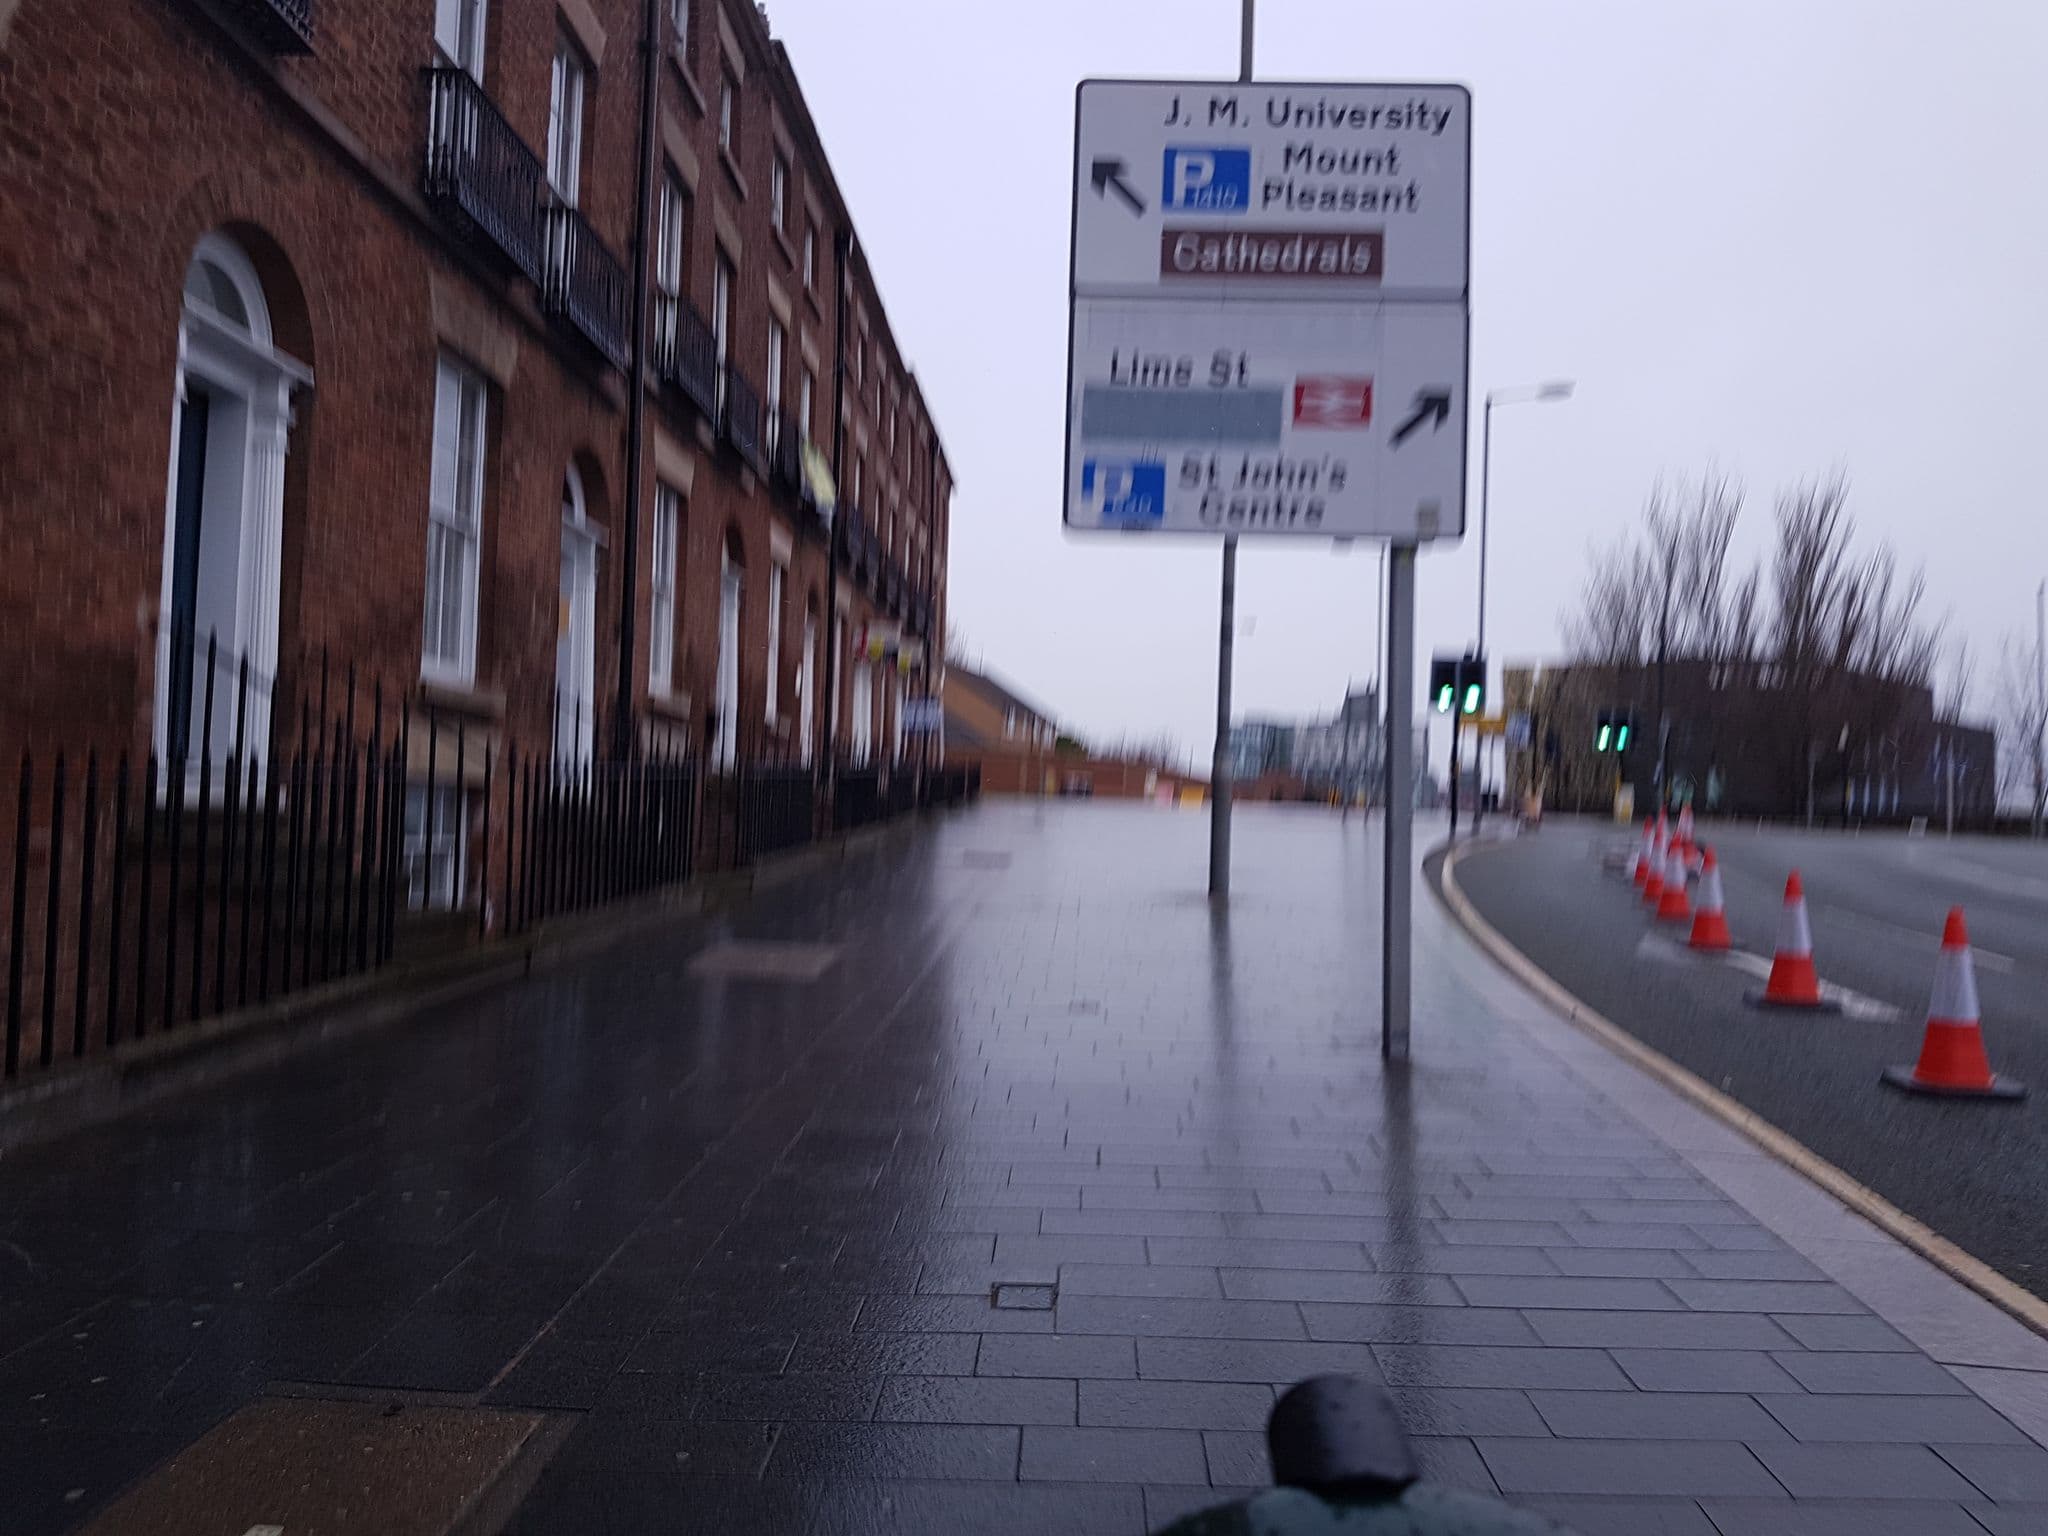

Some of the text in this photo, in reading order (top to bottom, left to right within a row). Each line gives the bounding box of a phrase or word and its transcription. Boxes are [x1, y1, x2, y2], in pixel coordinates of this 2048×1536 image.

[1207, 95, 1249, 128] M.
[1265, 96, 1453, 136] University
[1173, 150, 1216, 209] P
[1282, 142, 1401, 177] Mount
[1261, 177, 1421, 214] Pleasant
[1172, 231, 1373, 274] Cathedrals
[1109, 347, 1252, 388] Lime St
[1178, 451, 1347, 492] St John's
[1199, 493, 1327, 528] Centre
